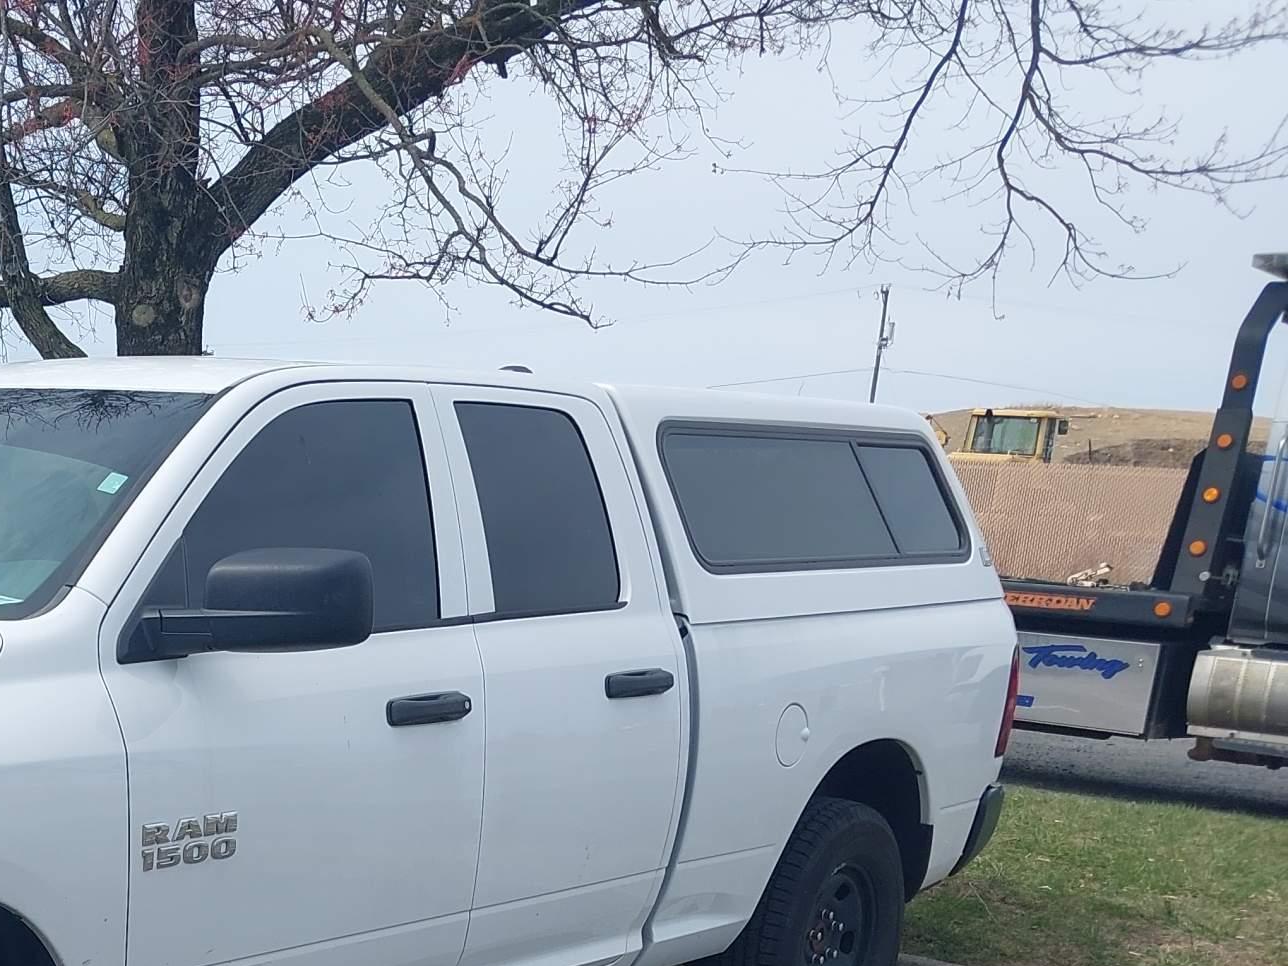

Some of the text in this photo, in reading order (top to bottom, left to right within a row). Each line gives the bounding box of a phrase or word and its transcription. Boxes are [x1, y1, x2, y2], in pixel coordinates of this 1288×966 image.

[1022, 644, 1130, 679] Towing
[142, 810, 238, 846] RAM
[142, 836, 237, 871] 1500
